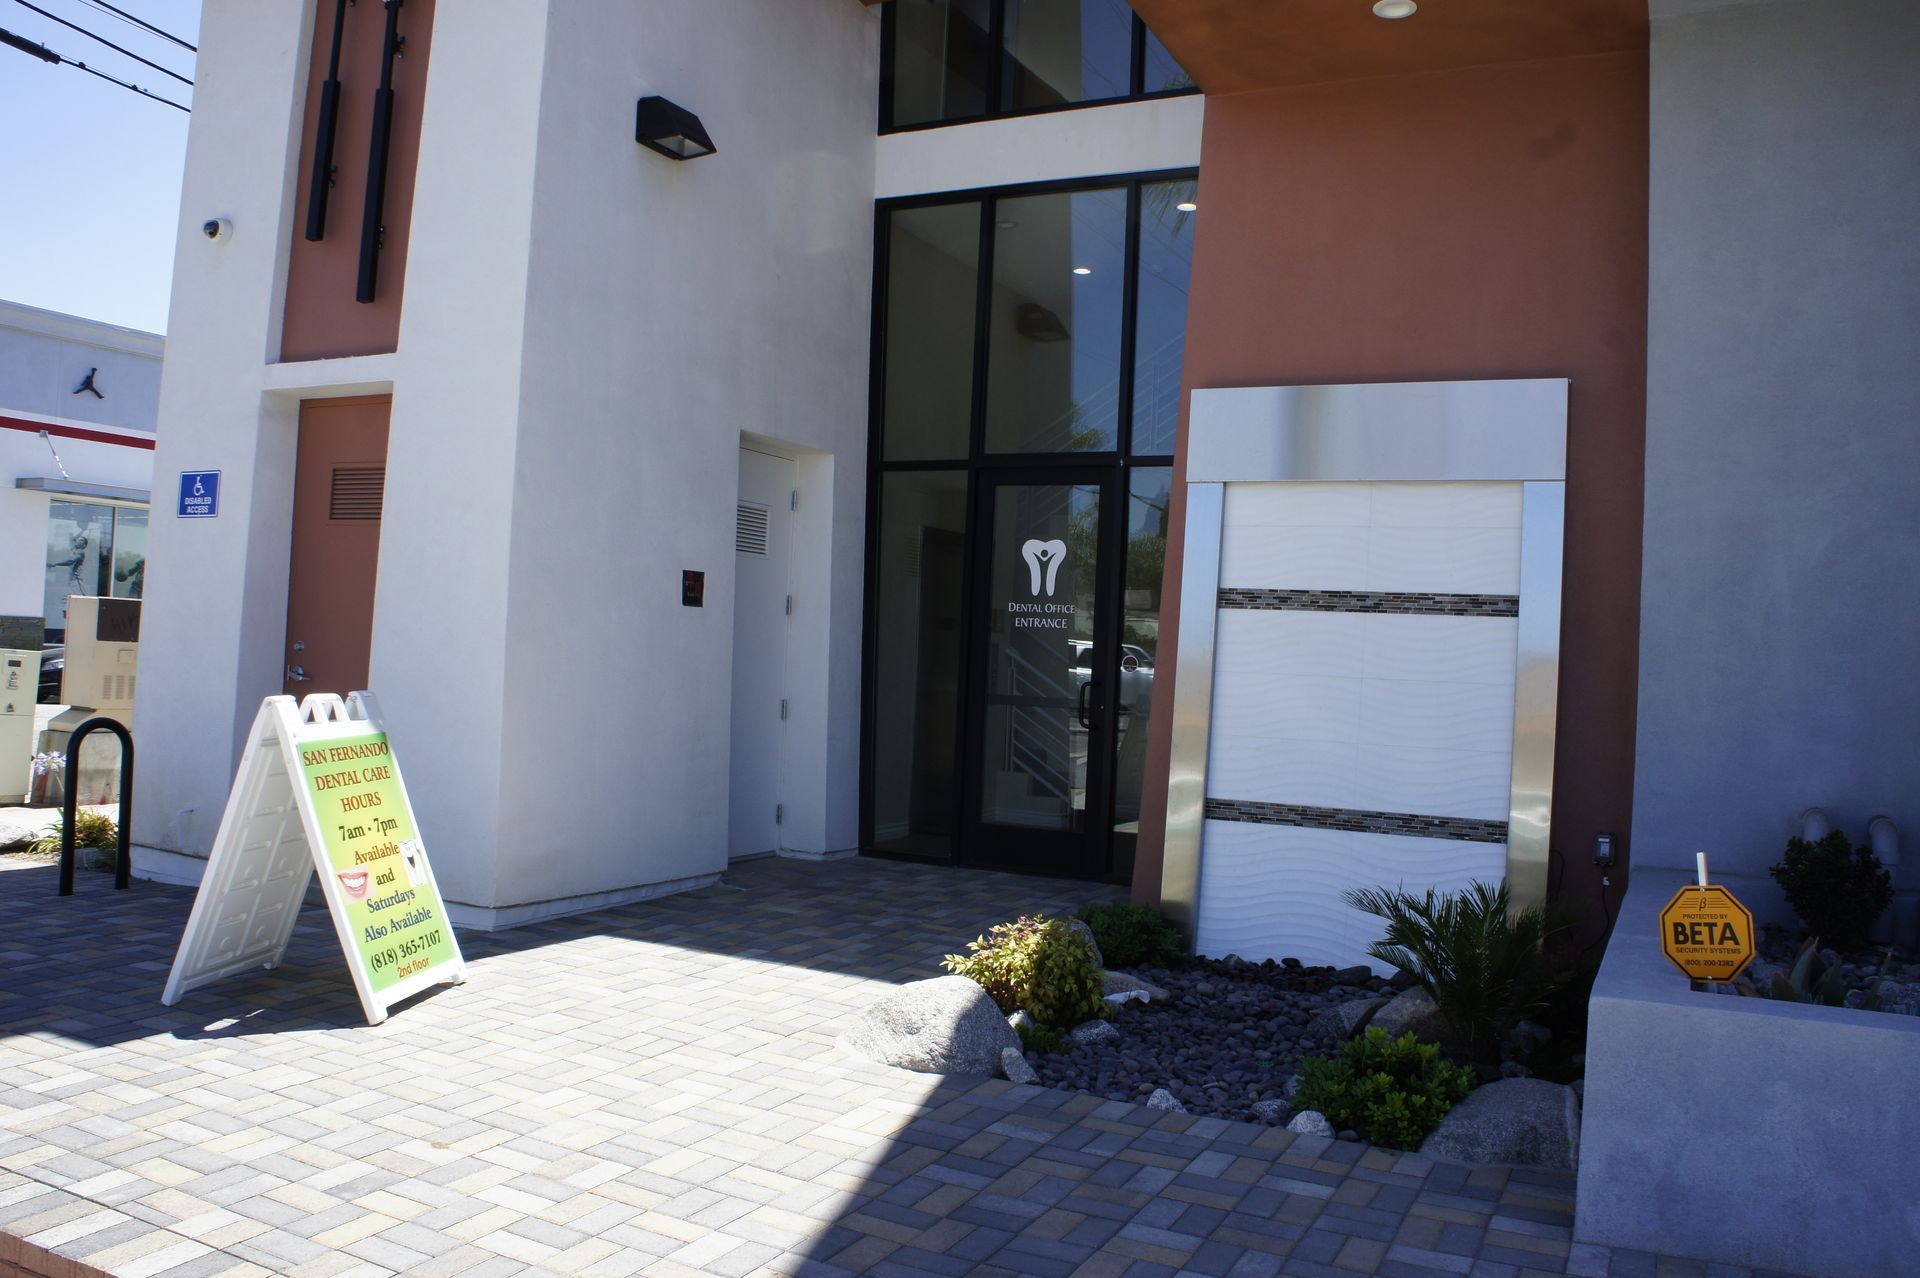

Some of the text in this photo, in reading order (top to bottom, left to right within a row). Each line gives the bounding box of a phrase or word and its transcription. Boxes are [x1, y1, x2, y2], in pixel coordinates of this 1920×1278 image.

[184, 497, 212, 505] DISABLED
[186, 505, 209, 514] ACCESS
[1015, 617, 1068, 629] ENTRANCE
[302, 741, 389, 767] SAN FERNANDO
[314, 765, 391, 791] DENTAL CARE
[340, 791, 382, 812] HOURS
[338, 825, 366, 841] 7am
[373, 817, 398, 837] 7pm
[354, 841, 400, 866] Available
[375, 867, 396, 886] and
[366, 889, 416, 914] Saturdays
[364, 906, 433, 943] Also Available
[1672, 921, 1741, 946] BETA
[370, 929, 442, 973] (818) 365-7107
[1675, 946, 1742, 955] SECURITY SYSTEMS
[396, 957, 430, 979] 2nd floor
